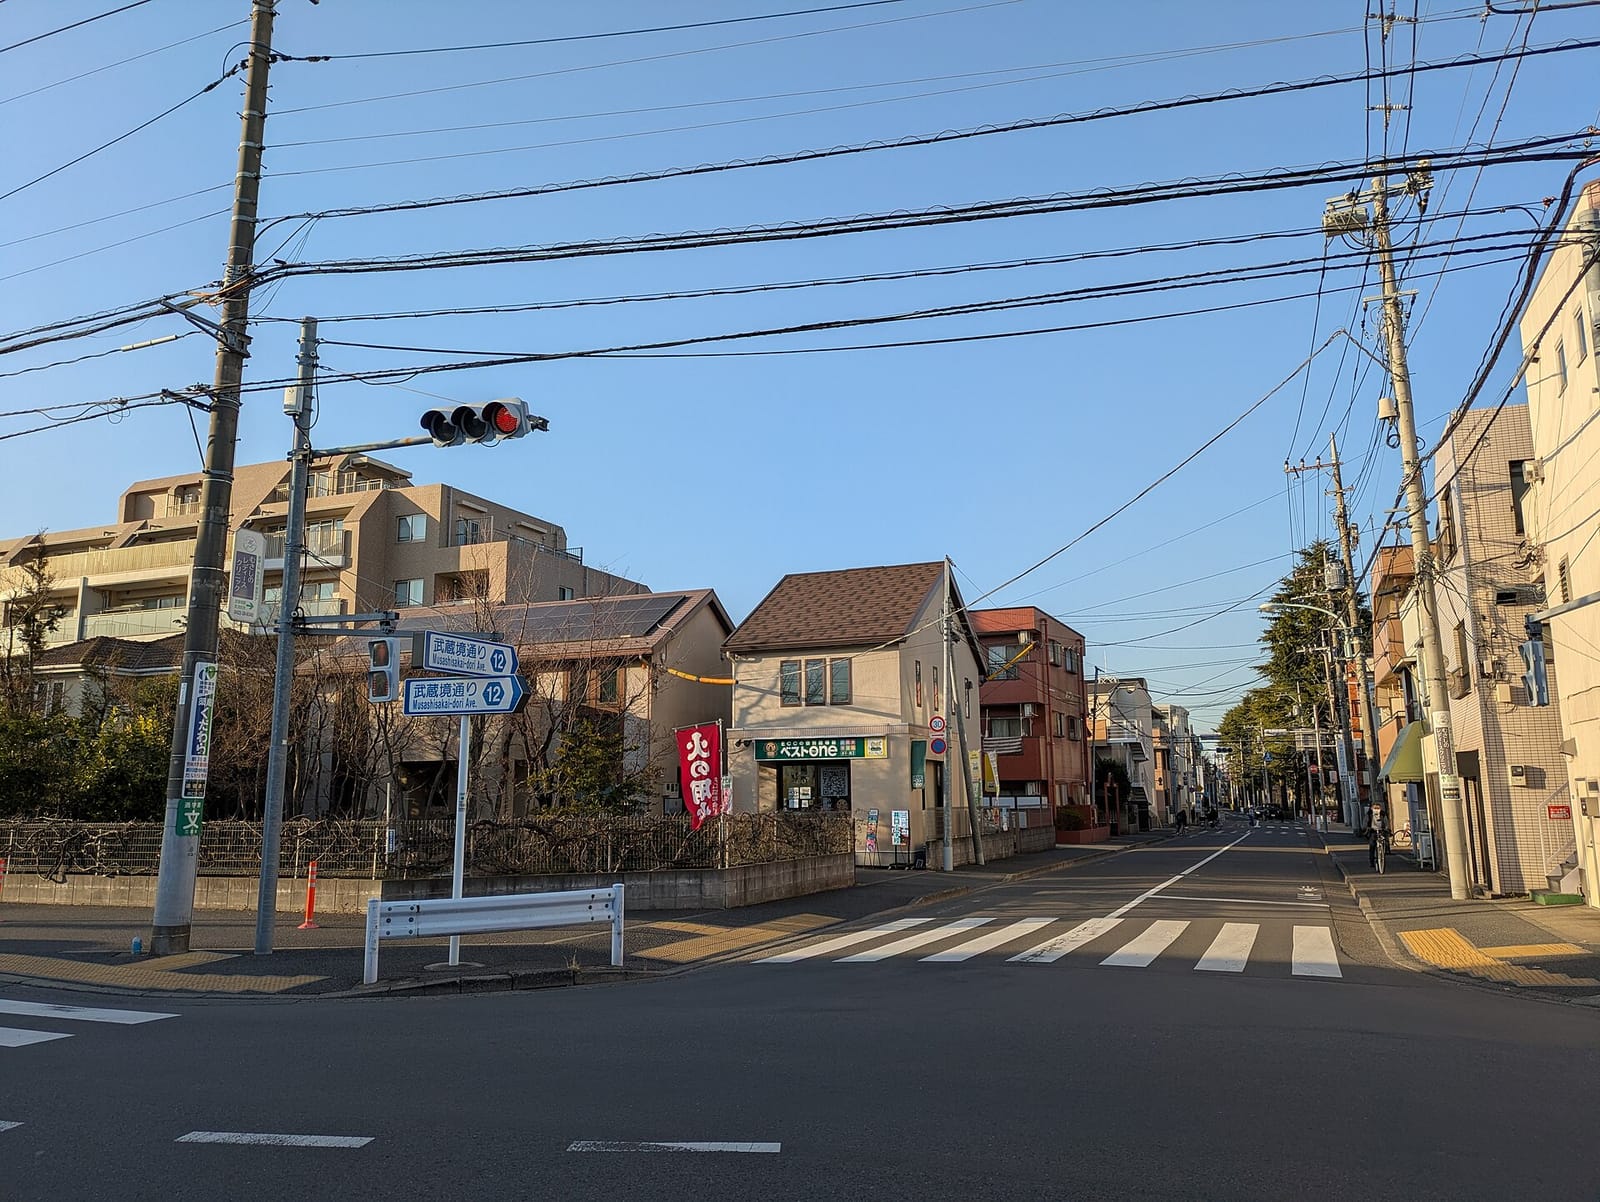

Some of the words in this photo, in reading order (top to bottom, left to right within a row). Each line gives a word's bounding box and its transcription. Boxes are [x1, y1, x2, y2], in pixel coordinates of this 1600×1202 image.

[234, 559, 242, 592] クリニック
[241, 556, 249, 590] レディース
[248, 556, 256, 584] むさしの
[432, 653, 476, 669] Musashisakai-dori
[476, 663, 486, 672] Ave.
[433, 638, 486, 660] 武蔵境通り
[493, 653, 504, 669] 12
[413, 682, 477, 699] 武蔵境通り
[487, 686, 501, 703] 12
[412, 698, 464, 709] Musashisakai-dori
[465, 698, 477, 709] Ave.
[933, 720, 942, 728] 30
[183, 809, 200, 829] 文
